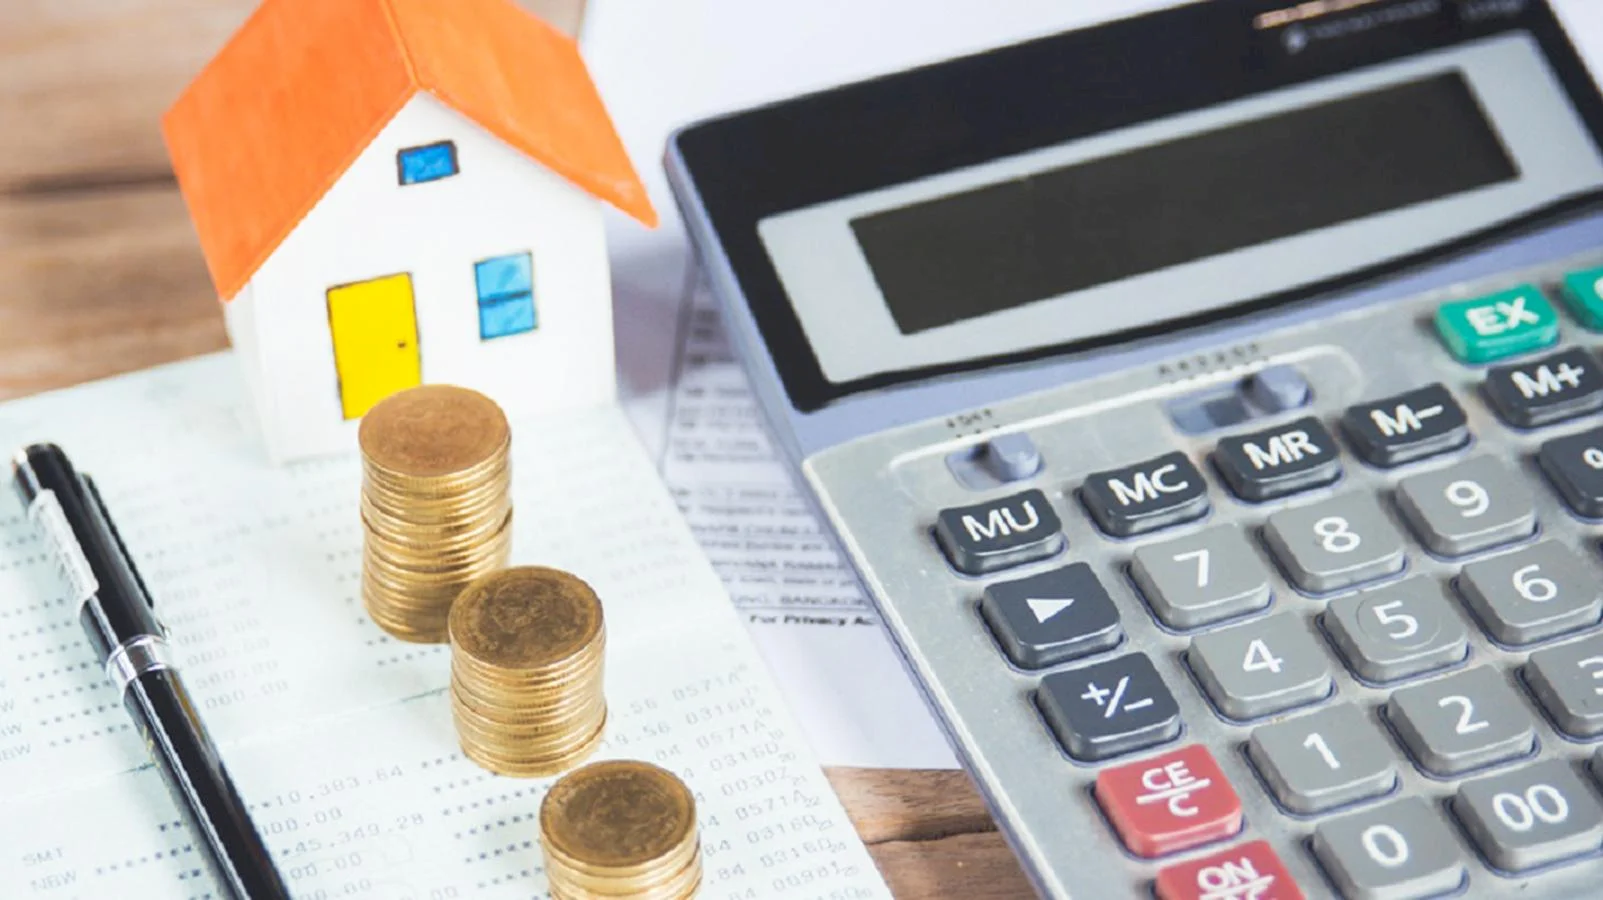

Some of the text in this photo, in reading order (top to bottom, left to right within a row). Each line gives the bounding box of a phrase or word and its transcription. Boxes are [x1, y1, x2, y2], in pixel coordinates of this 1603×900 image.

[1465, 296, 1541, 336] EX
[1510, 363, 1585, 399] M+
[1370, 404, 1444, 438] M-
[1241, 428, 1321, 471] MR
[1107, 463, 1189, 507] MC
[1445, 480, 1490, 518] 9
[961, 500, 1040, 542] MU
[1313, 516, 1361, 553] 8
[1172, 549, 1210, 588] 7
[1512, 564, 1558, 602] 6
[1372, 600, 1419, 640] 5
[1242, 638, 1283, 674] 4
[1438, 695, 1490, 736] 2
[1303, 732, 1341, 770] 1
[1141, 760, 1197, 791] CE
[1168, 793, 1200, 818] C
[1491, 784, 1570, 833] 00
[1361, 824, 1409, 868] 0
[1197, 857, 1260, 891] ON
